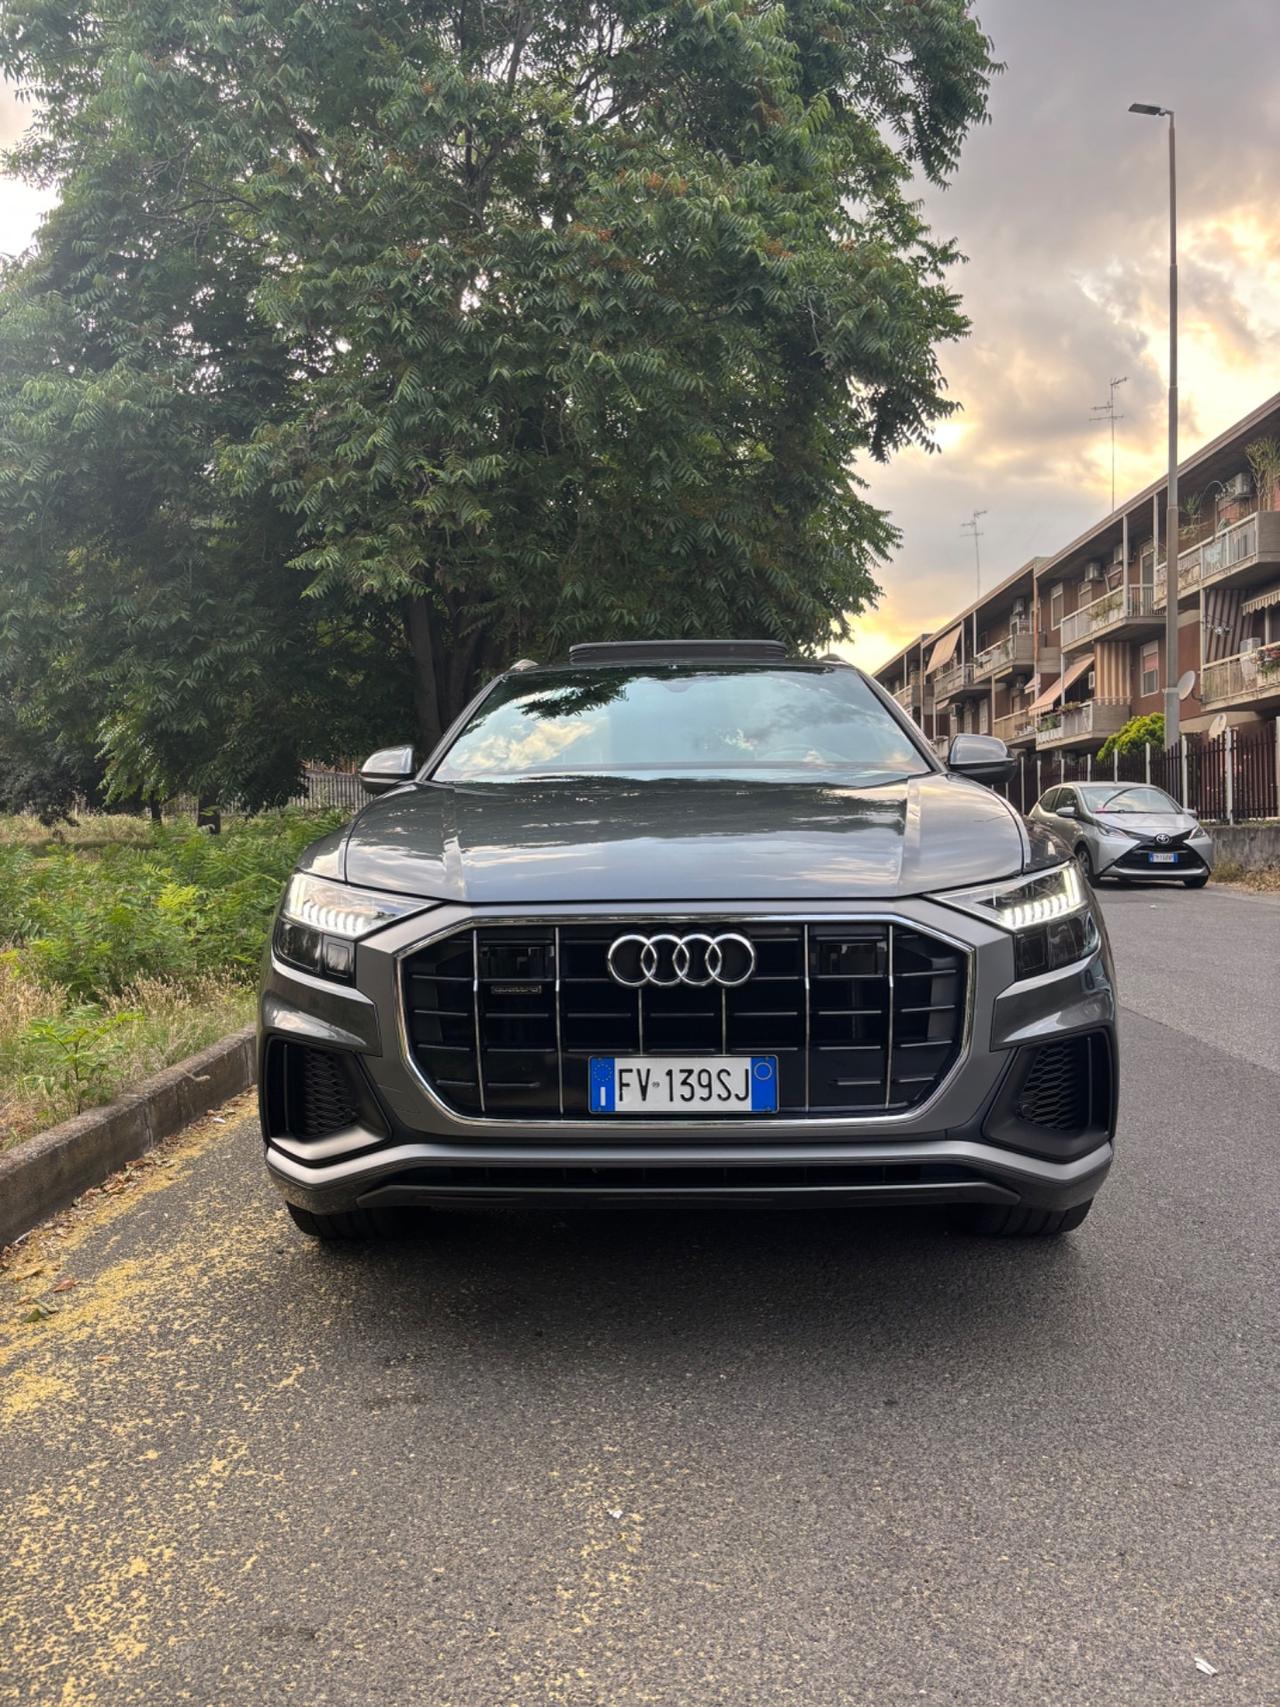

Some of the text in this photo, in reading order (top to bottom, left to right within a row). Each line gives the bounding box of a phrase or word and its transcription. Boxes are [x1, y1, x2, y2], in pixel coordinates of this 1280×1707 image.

[600, 1086, 606, 1106] I
[618, 1068, 750, 1102] FV 139SJ
